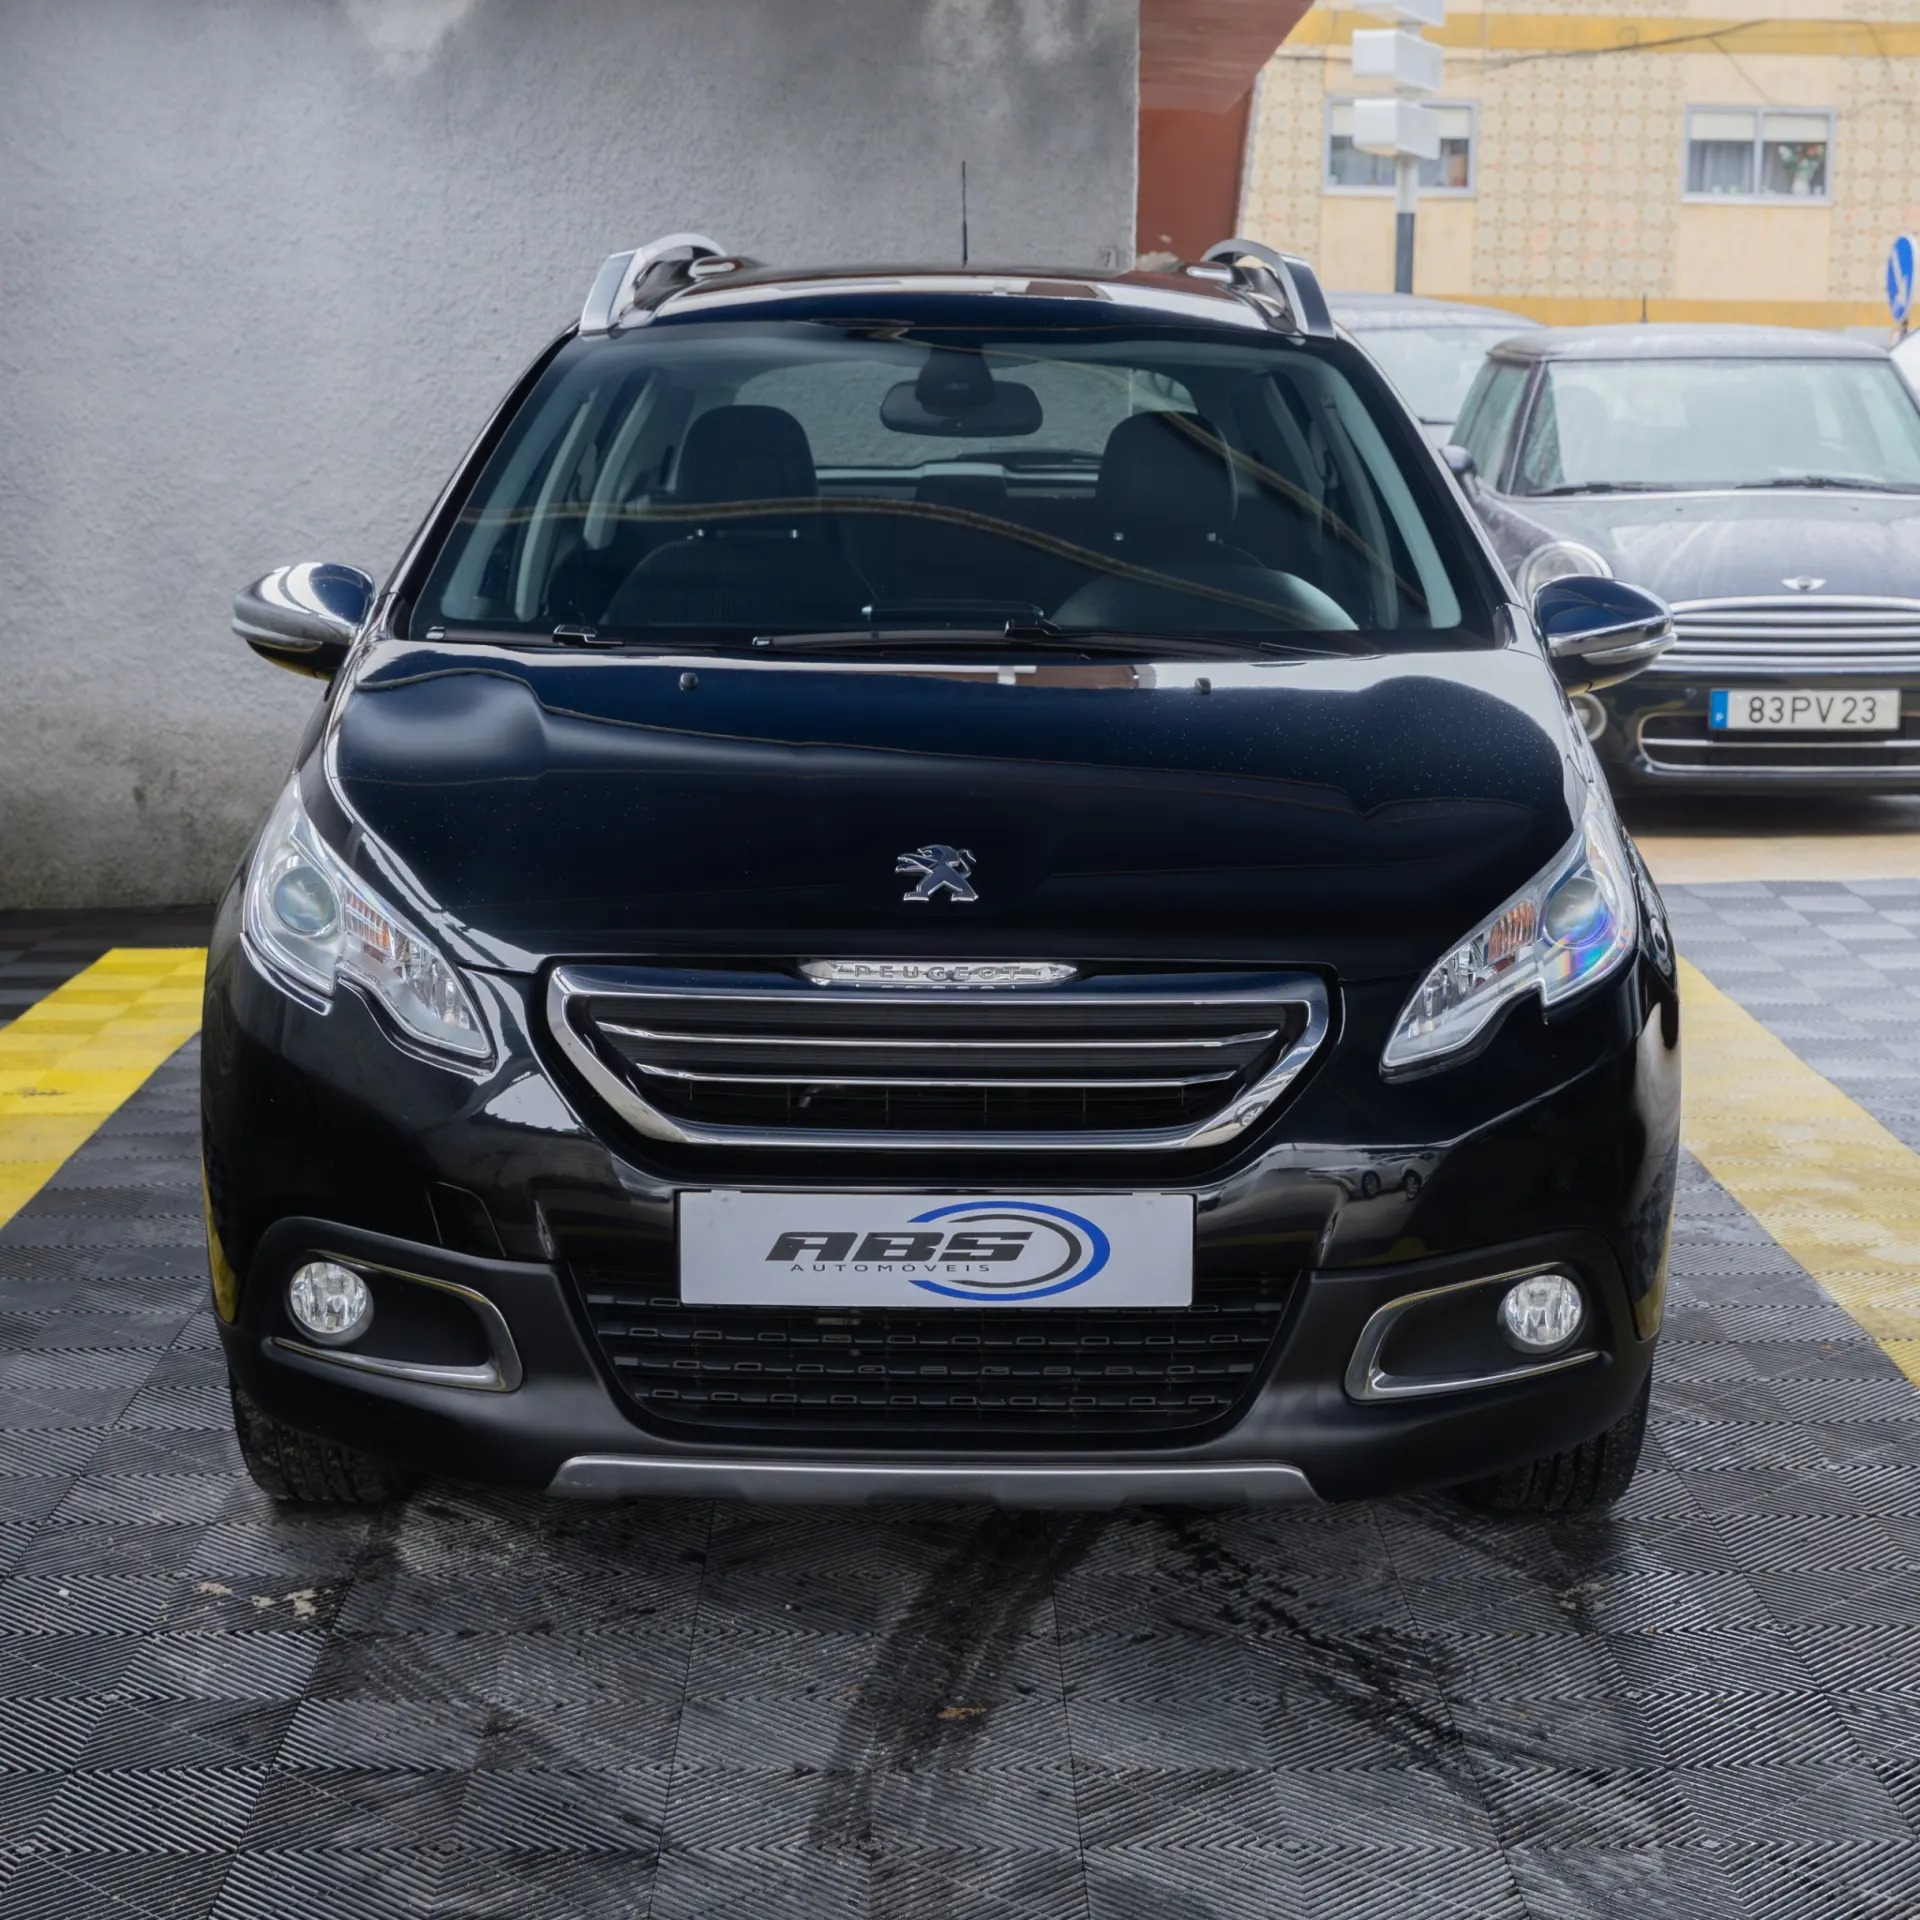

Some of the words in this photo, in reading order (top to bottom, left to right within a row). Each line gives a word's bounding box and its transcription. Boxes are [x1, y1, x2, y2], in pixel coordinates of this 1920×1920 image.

[854, 965, 1020, 981] PEUGEOT
[765, 1231, 1034, 1262] ABS
[790, 1263, 990, 1272] AUTOMÓVEIS
